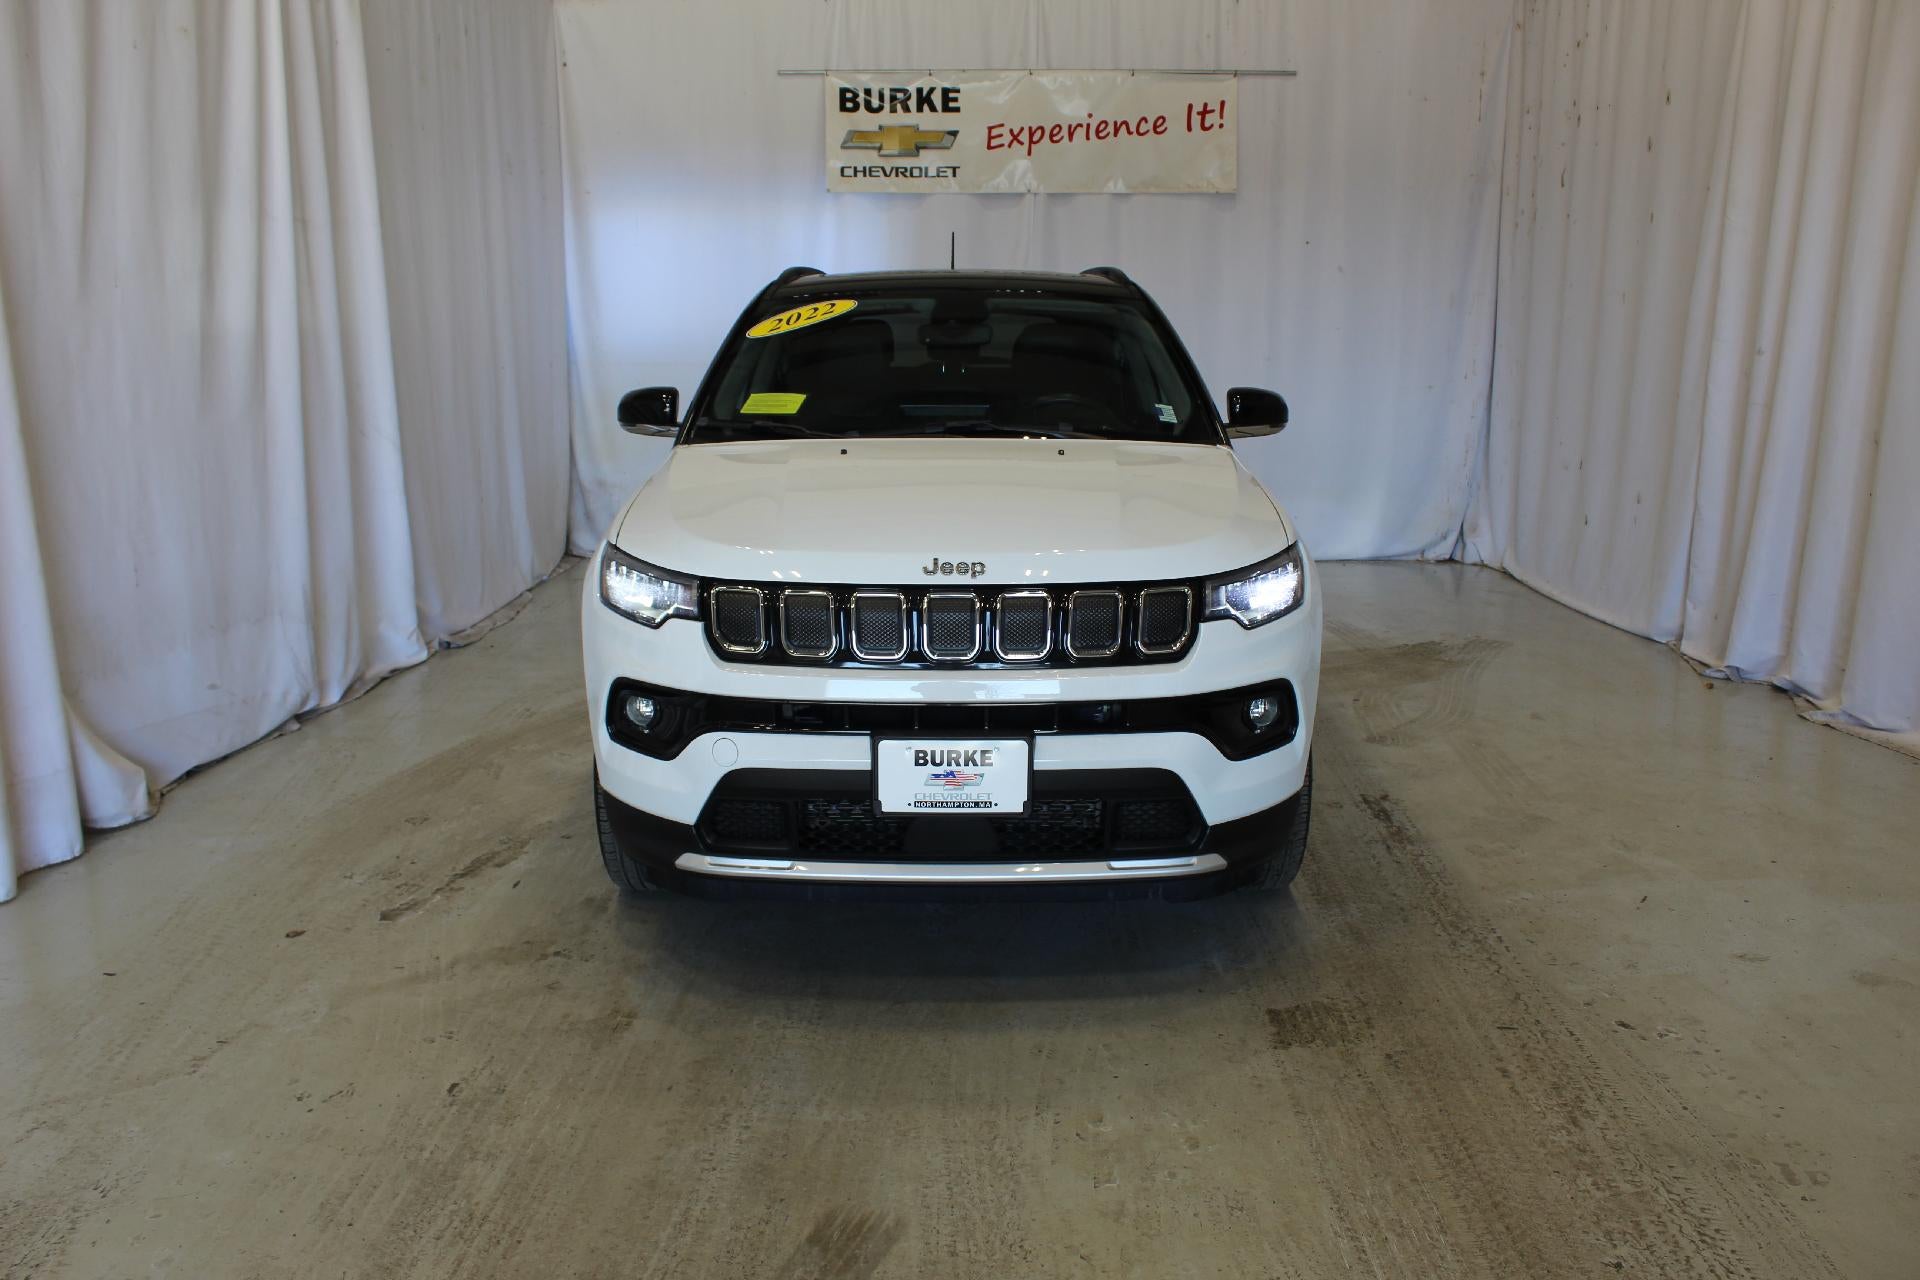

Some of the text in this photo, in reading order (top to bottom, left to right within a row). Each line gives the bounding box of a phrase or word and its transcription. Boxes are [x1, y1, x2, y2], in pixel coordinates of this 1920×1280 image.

[839, 87, 961, 113] BURKE
[985, 100, 1226, 156] Experience It!
[840, 165, 960, 178] CHEVROLET
[767, 302, 836, 333] 2022
[922, 557, 986, 579] Jeep
[914, 750, 993, 767] BURKE
[914, 792, 992, 801] CHEVROLET
